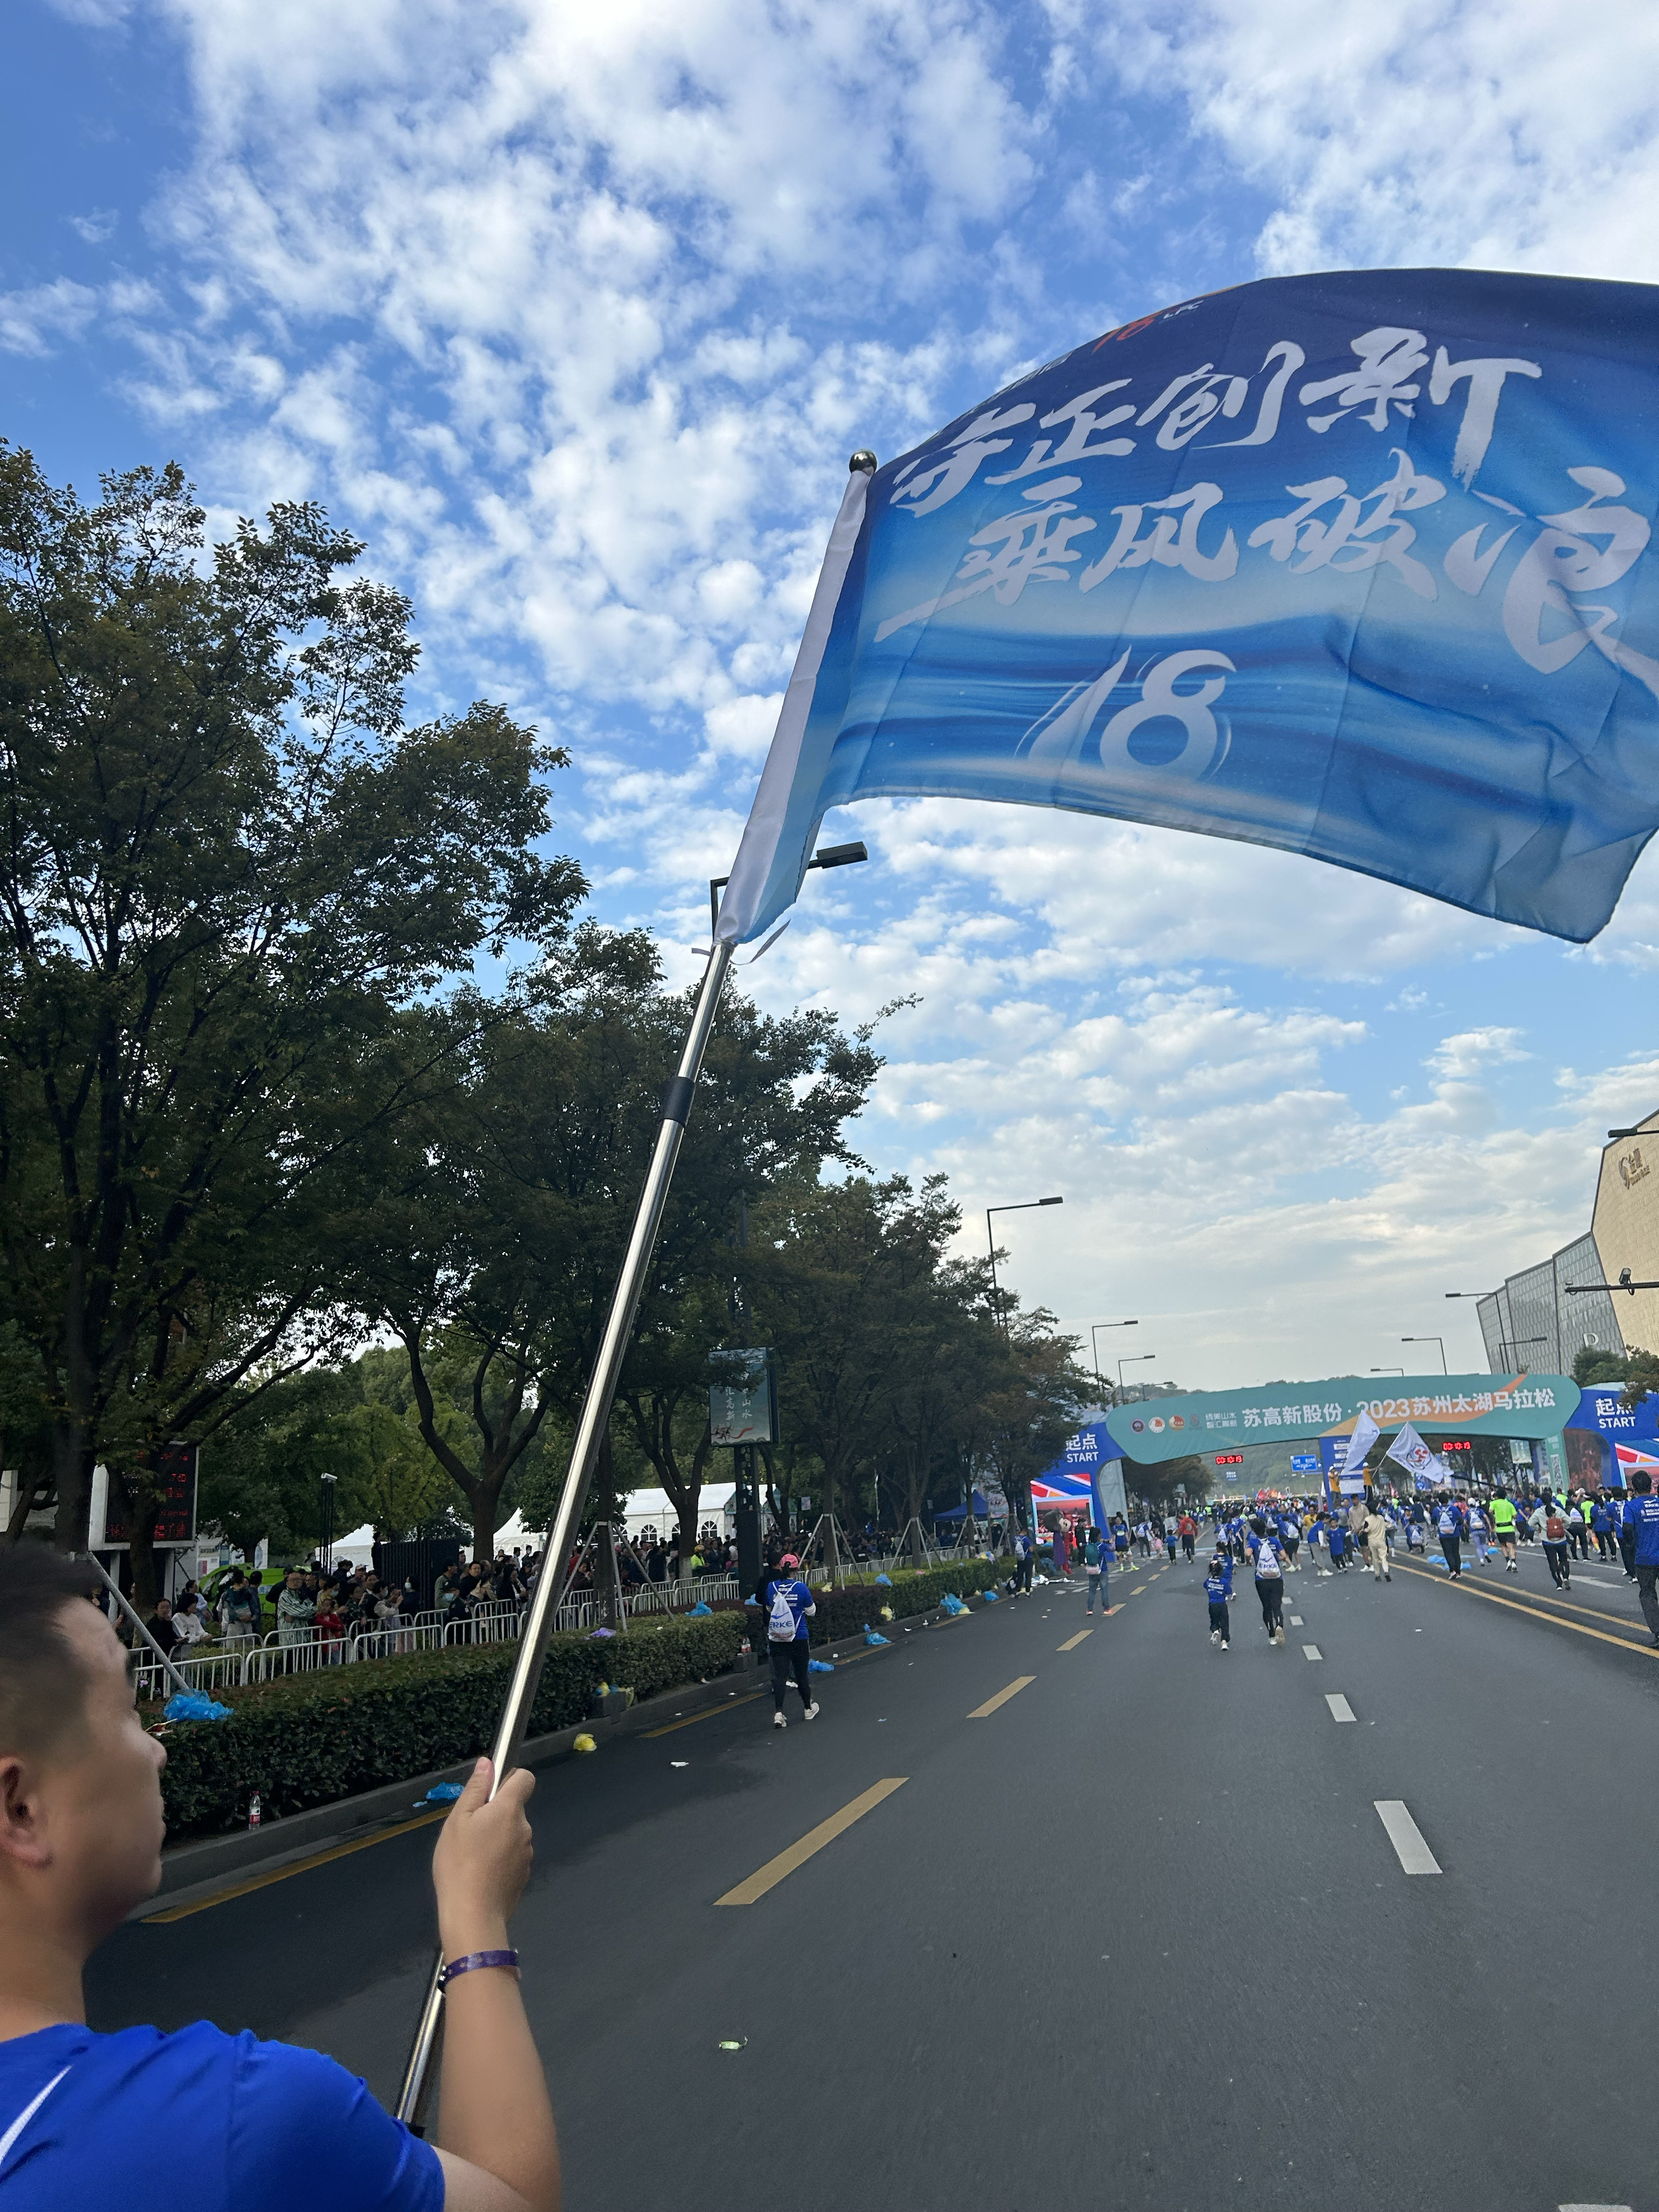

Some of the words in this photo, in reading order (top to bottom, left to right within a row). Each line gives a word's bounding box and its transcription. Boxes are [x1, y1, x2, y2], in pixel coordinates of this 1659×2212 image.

[890, 326, 1543, 517] 守正创新
[874, 447, 1659, 697] 乘风破浪
[1015, 644, 1238, 783] 18
[1066, 1433, 1097, 1451] 起点
[1066, 1452, 1098, 1463] START
[1599, 1416, 1636, 1429] START
